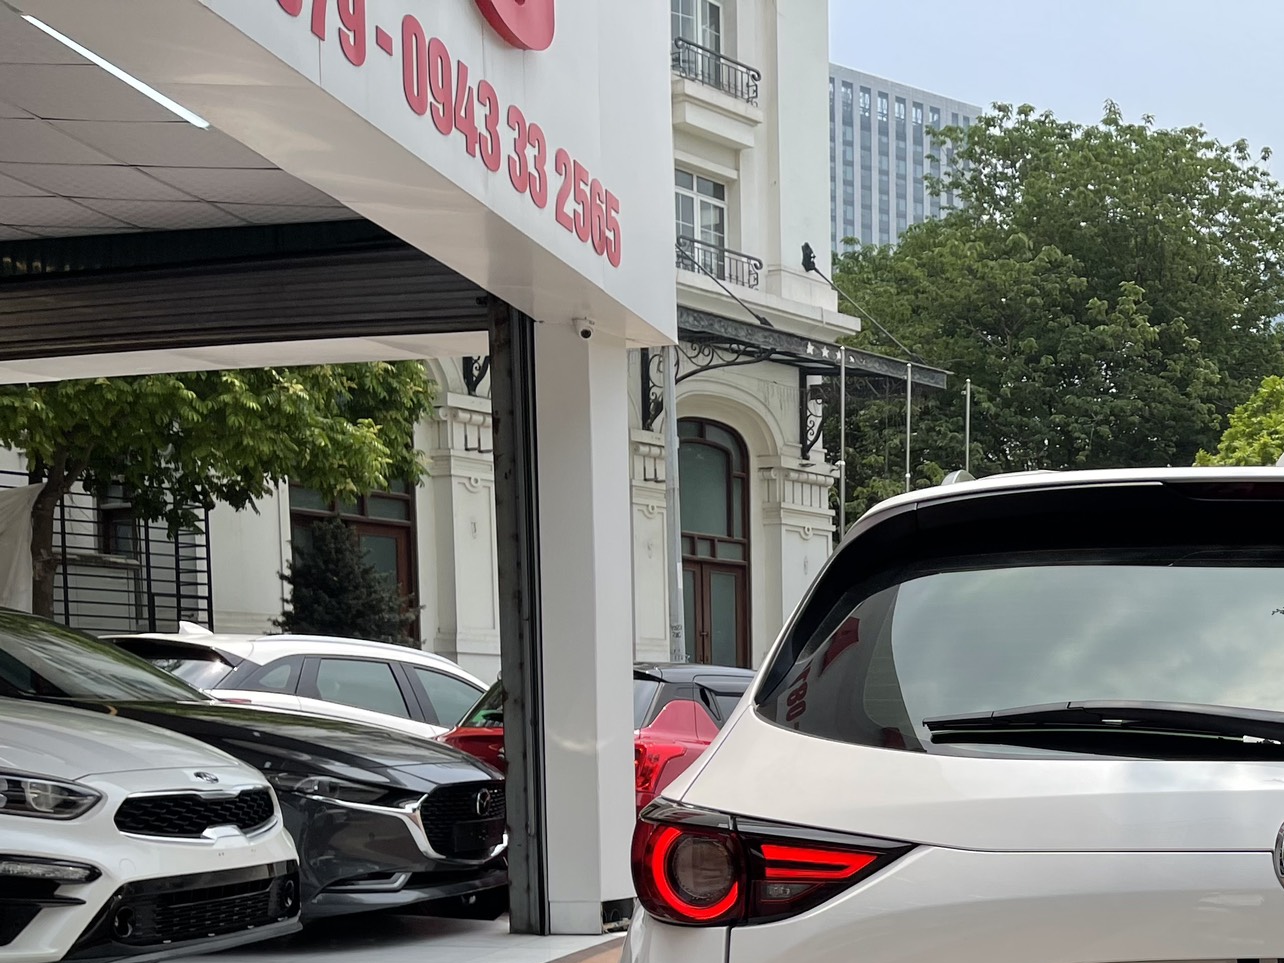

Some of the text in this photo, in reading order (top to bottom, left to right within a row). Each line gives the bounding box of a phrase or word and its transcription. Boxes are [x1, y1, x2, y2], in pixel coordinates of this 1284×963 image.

[402, 14, 501, 172] 0943
[507, 105, 548, 208] 33
[555, 148, 621, 268] 2565
